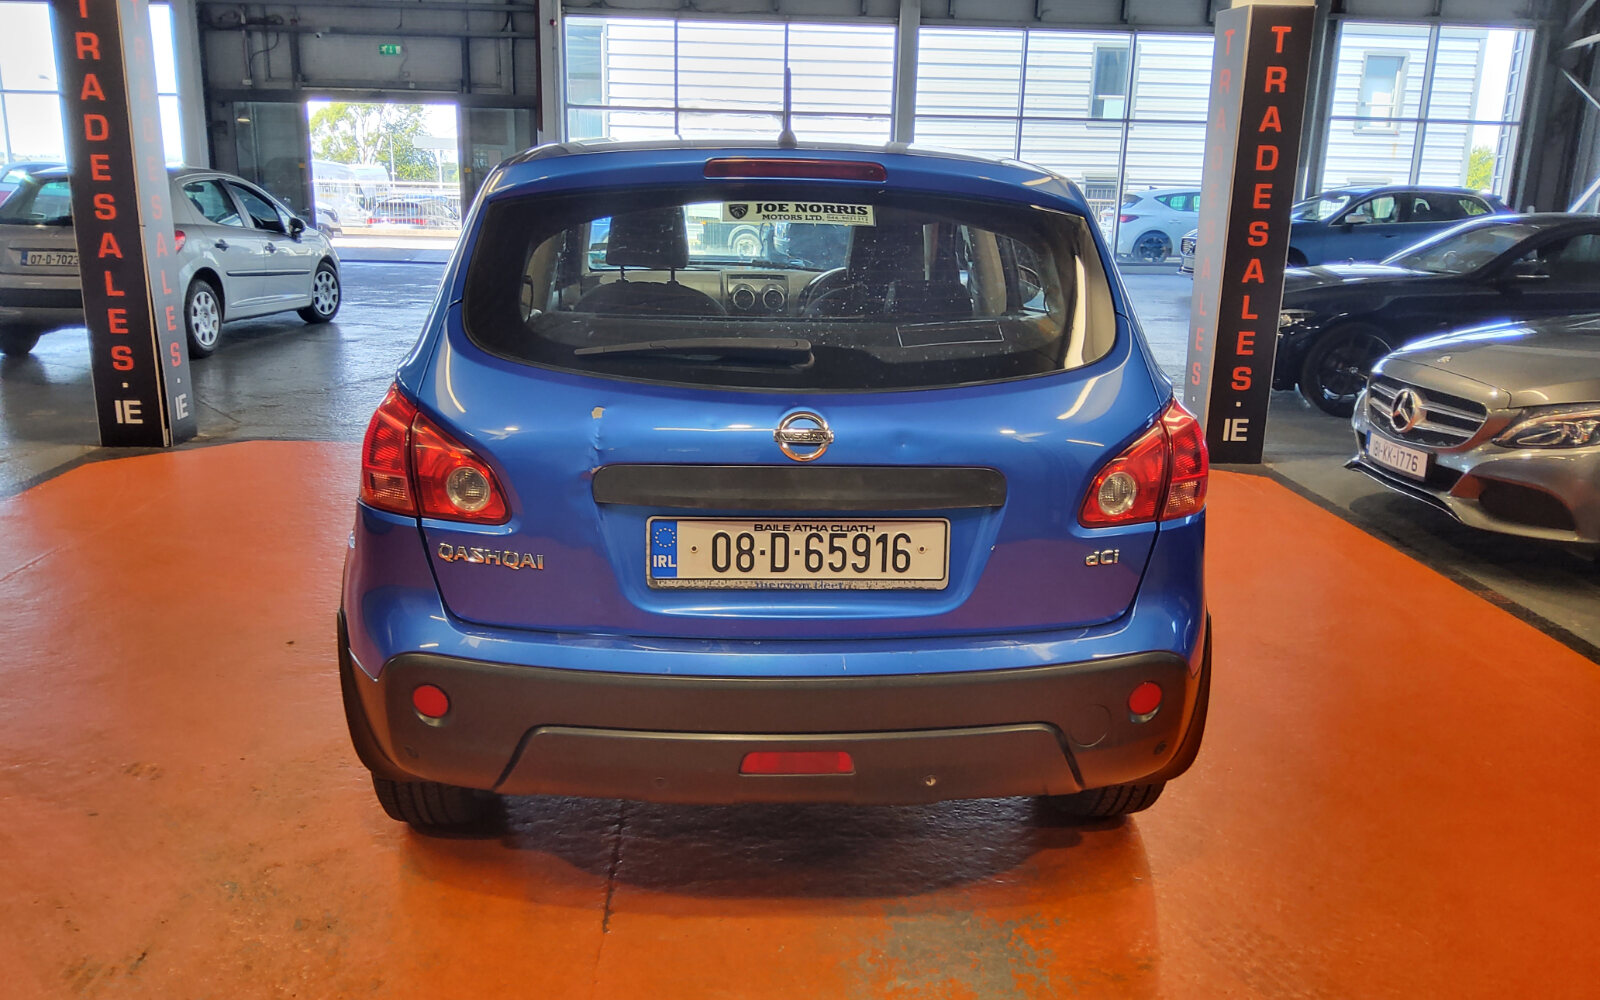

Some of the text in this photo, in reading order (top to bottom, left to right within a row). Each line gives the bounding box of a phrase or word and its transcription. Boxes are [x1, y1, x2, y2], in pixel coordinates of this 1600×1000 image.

[756, 203, 868, 215] JOE NORRIS
[754, 524, 791, 532] BAILE
[830, 525, 876, 533] CLIATH
[438, 542, 544, 570] QASHQAI
[652, 555, 677, 568] IRL
[1085, 549, 1120, 566] dCi
